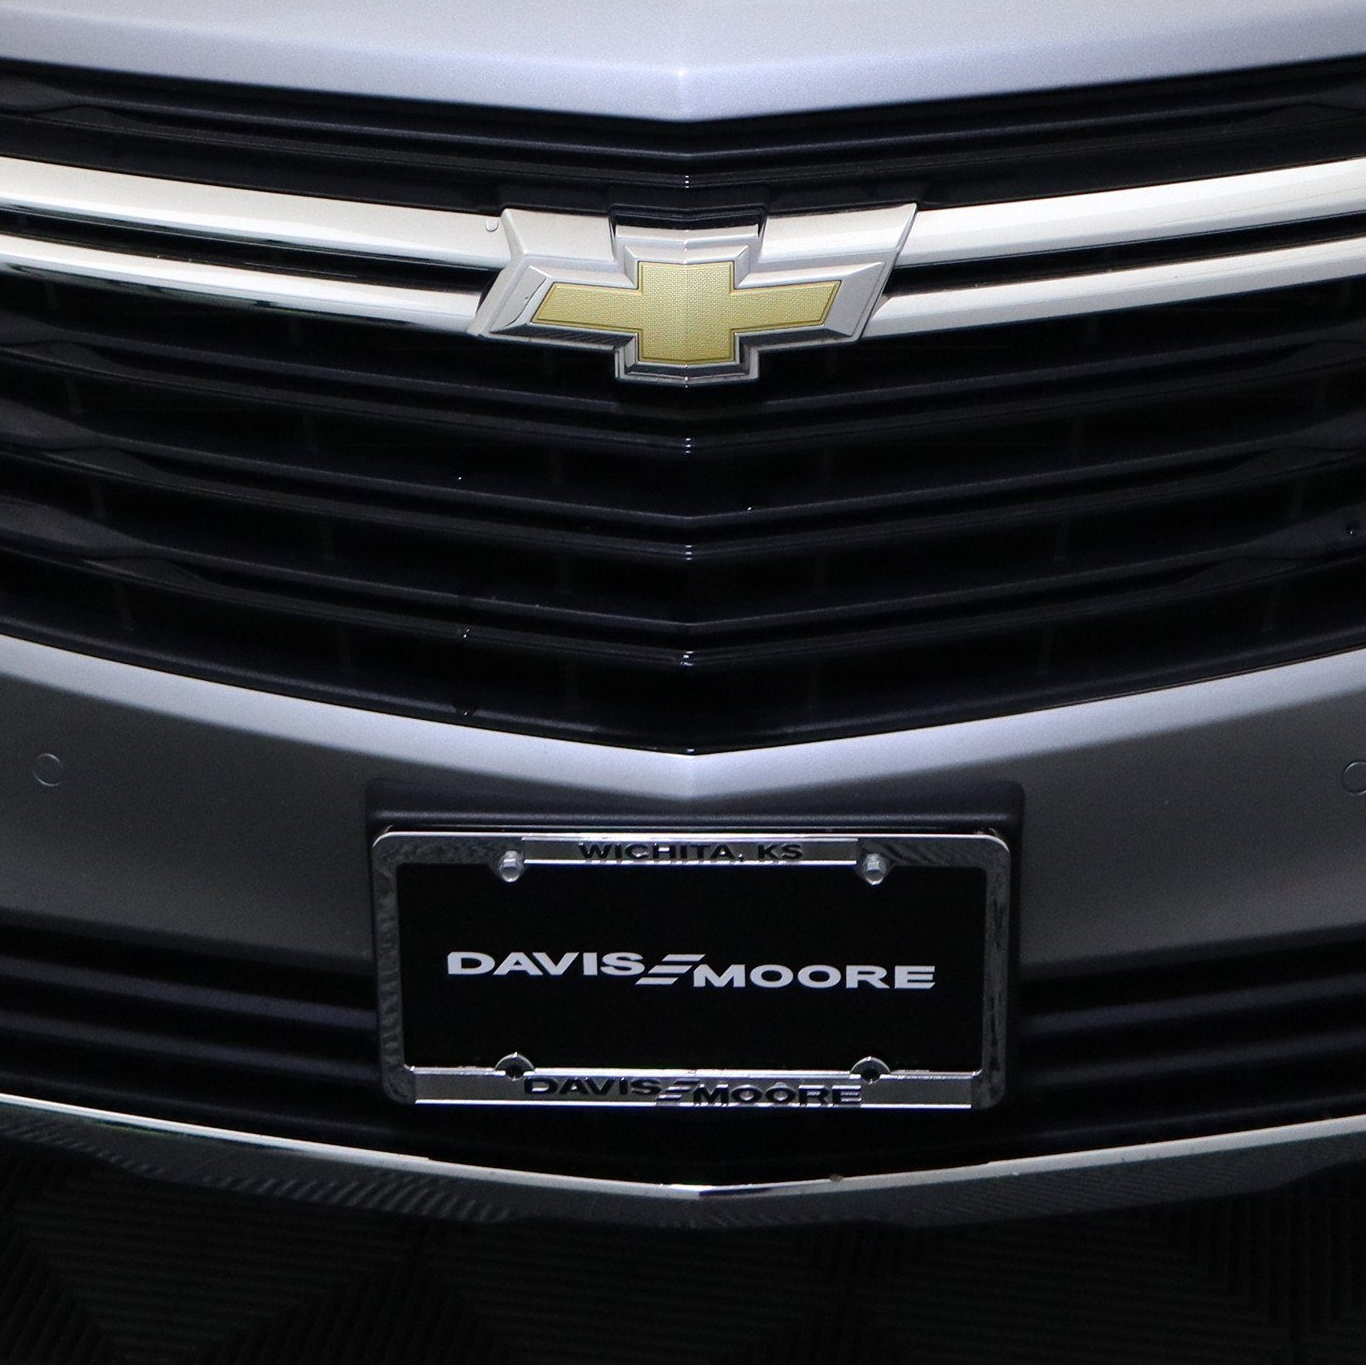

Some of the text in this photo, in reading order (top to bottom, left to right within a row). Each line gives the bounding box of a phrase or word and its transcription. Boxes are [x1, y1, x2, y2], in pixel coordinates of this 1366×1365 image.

[758, 842, 804, 861] KS
[447, 951, 935, 989] DAVIS MOORE
[524, 1078, 862, 1108] DAVIS MOORE
